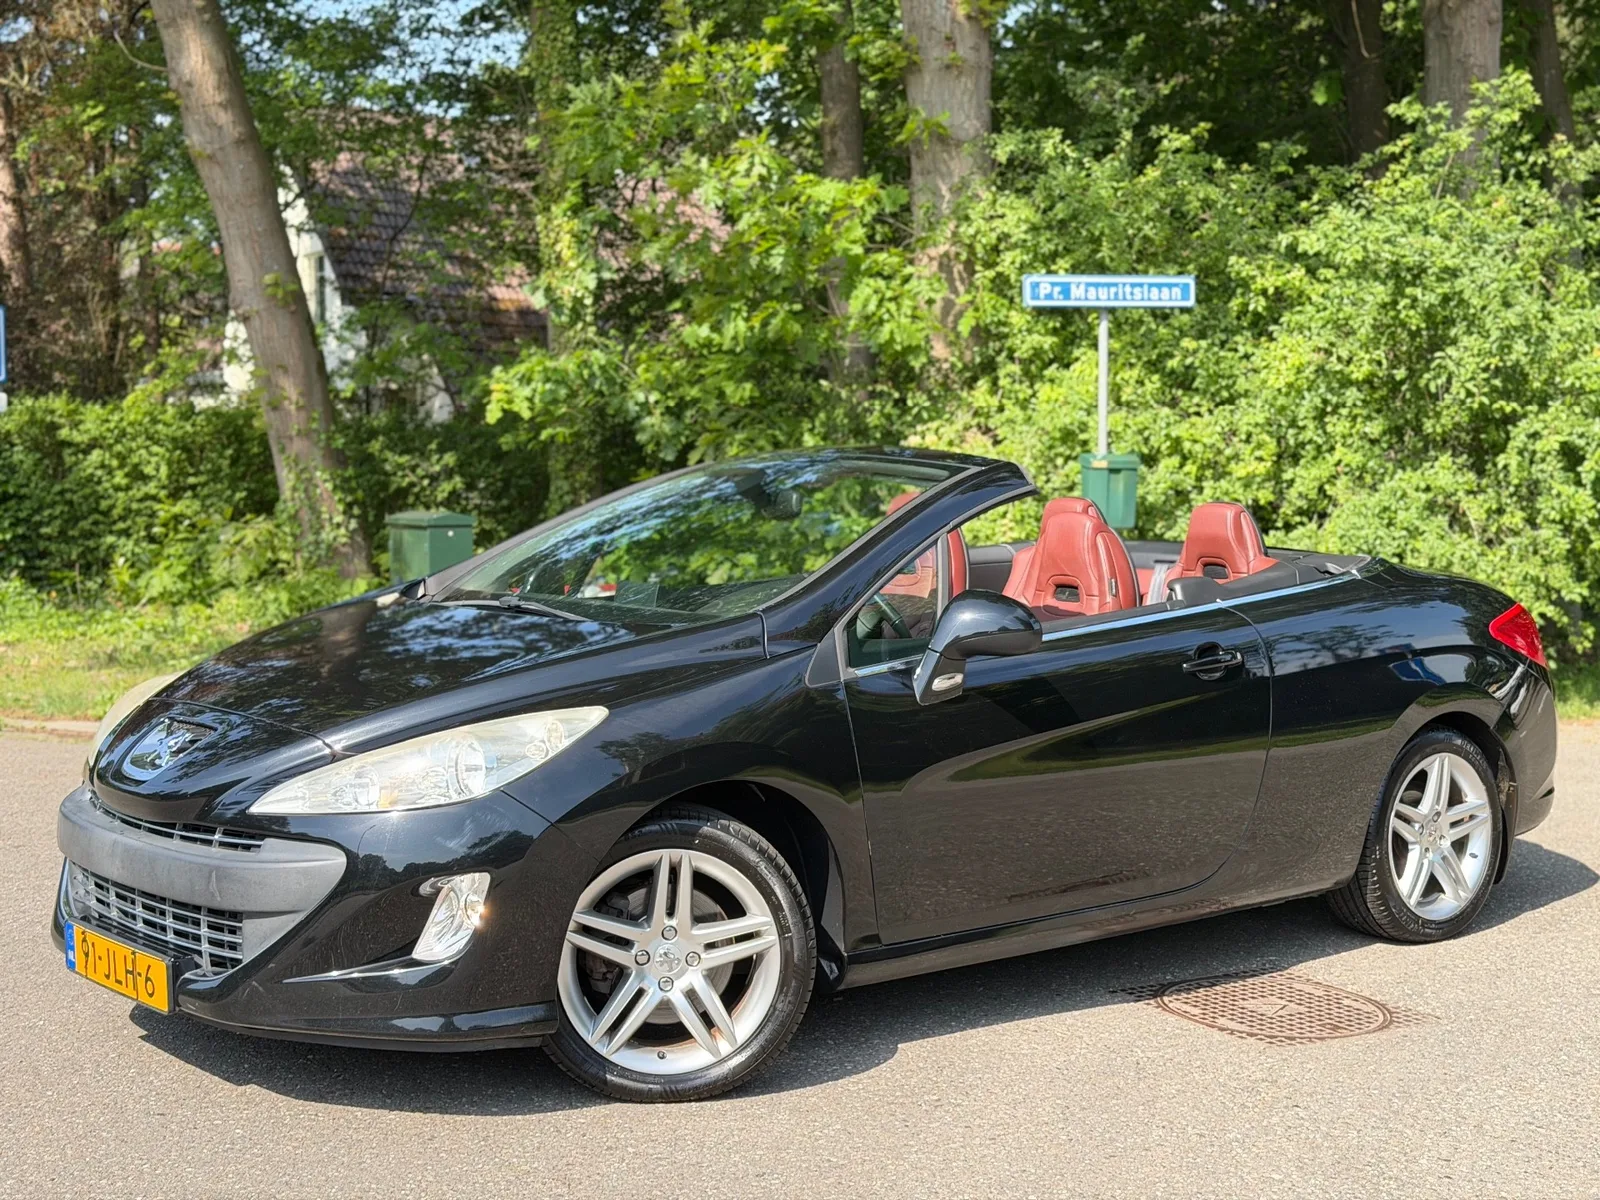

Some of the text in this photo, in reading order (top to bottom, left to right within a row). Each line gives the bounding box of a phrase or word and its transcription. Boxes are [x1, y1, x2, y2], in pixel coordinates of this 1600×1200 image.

[1038, 282, 1183, 300] Pr. Mauritslaan
[81, 933, 155, 998] 91-JLH-6
